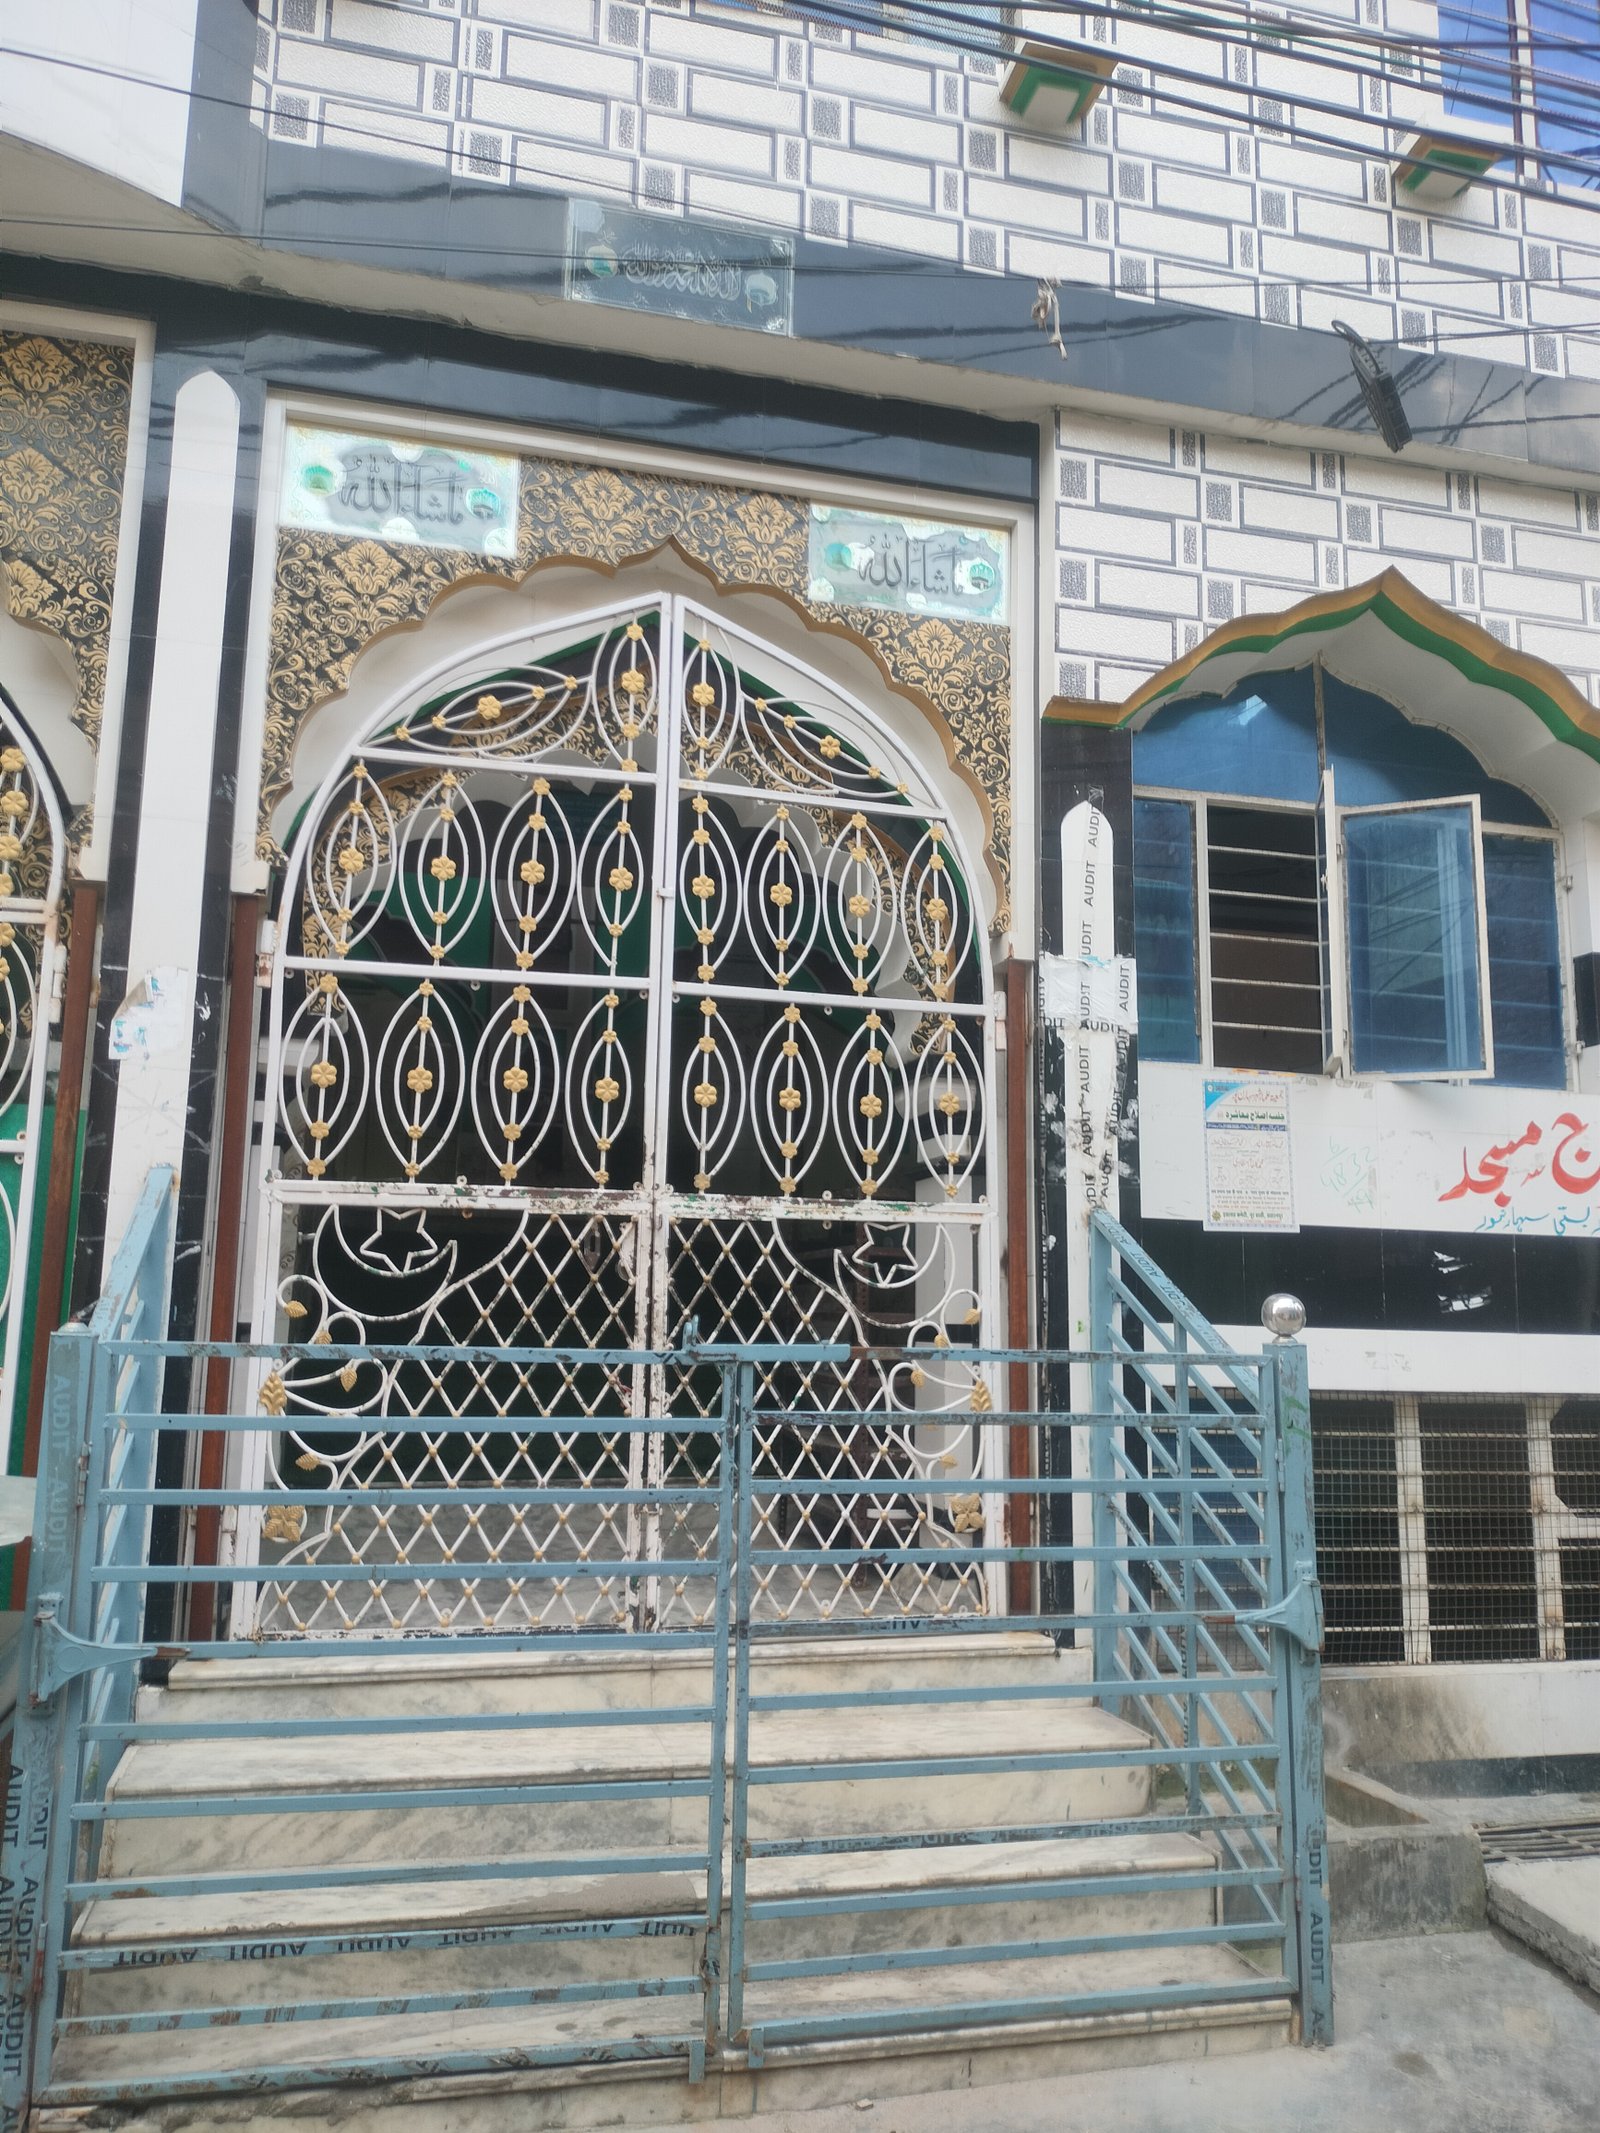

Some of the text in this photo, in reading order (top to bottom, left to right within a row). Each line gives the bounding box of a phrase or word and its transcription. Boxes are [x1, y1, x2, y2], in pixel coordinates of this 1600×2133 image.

[1088, 806, 1101, 848] AUDIT
[1084, 860, 1096, 908] AUDIT
[1082, 920, 1093, 956] UDIT
[1119, 965, 1130, 1013] AUDIT
[1079, 1045, 1090, 1094] AUDIT
[1085, 1172, 1097, 1208] UDIT
[1108, 1087, 1121, 1136] AUDIT
[1130, 1250, 1161, 1278] AUDIT
[28, 1799, 49, 1850] DIT
[14, 1877, 39, 1963] AUDIT
[224, 1941, 308, 1962] AUDIT
[1310, 1911, 1325, 1985] AUDIT
[3, 1992, 26, 2077] AUDIT
